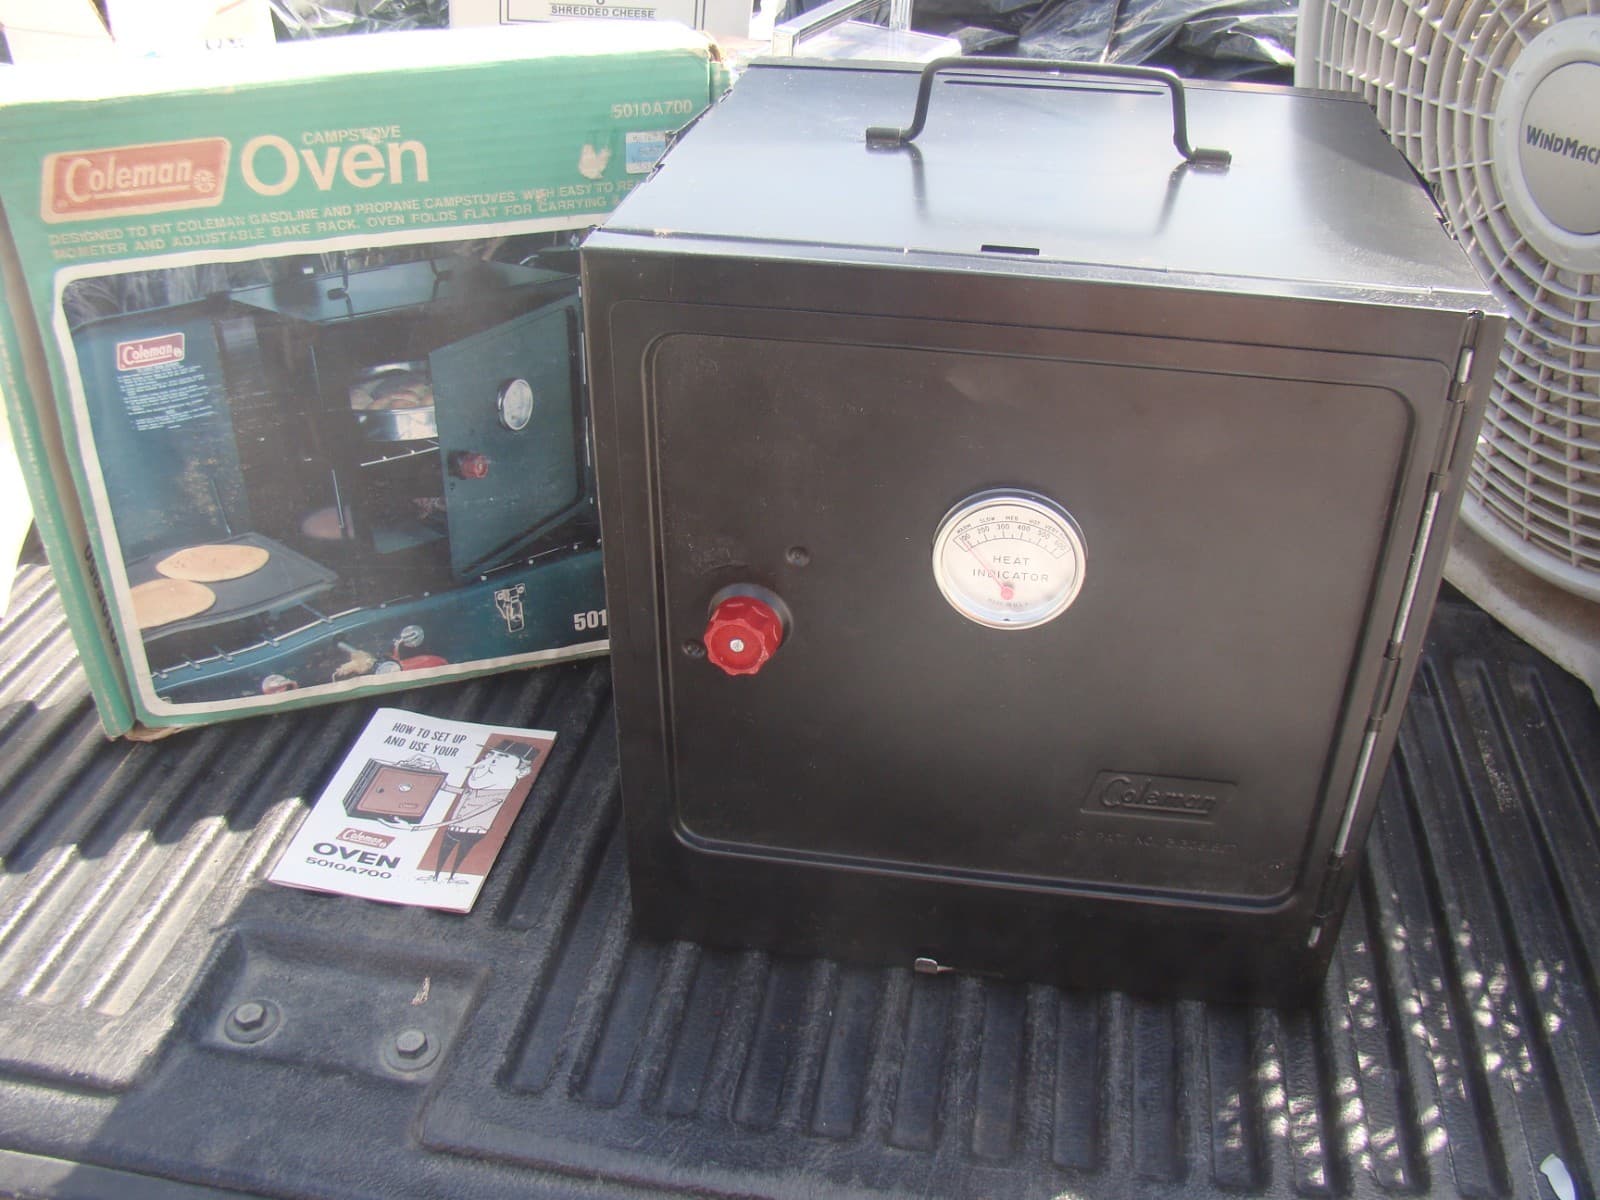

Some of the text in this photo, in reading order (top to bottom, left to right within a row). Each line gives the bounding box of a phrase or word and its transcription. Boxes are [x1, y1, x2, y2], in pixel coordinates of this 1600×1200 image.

[551, 5, 654, 18] SHREDDED CHEESE
[612, 99, 692, 119] 5010A700
[303, 125, 400, 145] CAMPSTOVE
[241, 135, 428, 196] Oven
[65, 157, 192, 202] Coleman
[50, 228, 123, 245] DESIGNED
[126, 226, 147, 237] TO
[151, 223, 172, 235] FIT
[177, 216, 245, 232] COLEMAN
[250, 208, 319, 225] GASOLINE
[324, 205, 351, 217] AND
[355, 200, 420, 215] PROPANE
[560, 184, 592, 197] EASY
[597, 182, 613, 193] TO
[134, 239, 165, 251] AND
[172, 228, 265, 248] ADJUSTABLE
[272, 223, 310, 237] BAKE
[367, 214, 405, 228] OVEN
[412, 210, 457, 223] FOLDS
[464, 206, 498, 219] FLAT
[504, 204, 532, 216] FOR
[538, 197, 607, 213] CARRYING
[123, 344, 173, 366] Coleman
[977, 526, 990, 534] 200
[1017, 524, 1031, 532] 400
[993, 555, 1030, 566] HEAT
[973, 568, 1049, 582] INDICATOR
[573, 609, 609, 631] 501
[392, 722, 467, 744] HOW TO SET UP
[384, 735, 459, 757] AND USE YOUR
[1101, 776, 1217, 811] Coleman
[341, 828, 382, 846] Coleman
[313, 842, 401, 869] OVEN
[305, 856, 392, 879] 5010A700
